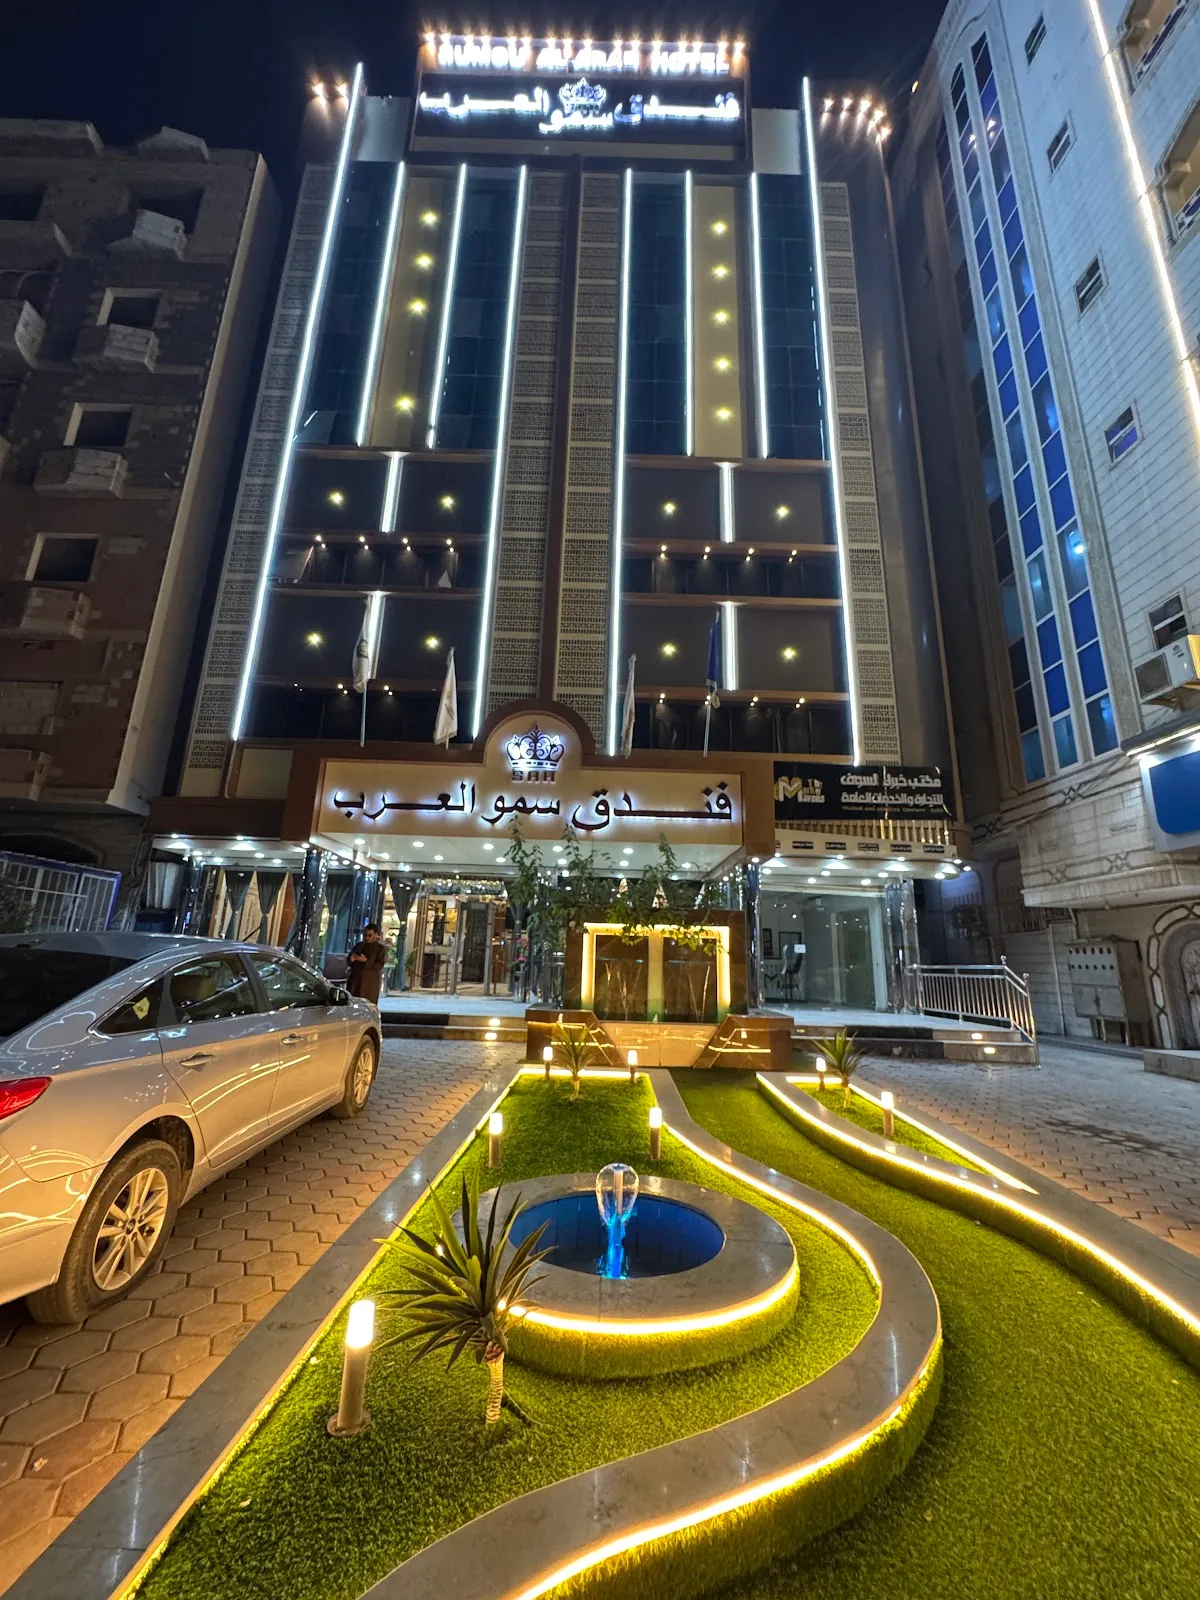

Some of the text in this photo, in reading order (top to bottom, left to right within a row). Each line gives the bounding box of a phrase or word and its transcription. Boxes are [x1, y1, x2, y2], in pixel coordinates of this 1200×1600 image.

[651, 50, 730, 74] HOTEL
[908, 774, 942, 789] مكتب
[333, 780, 732, 832] فندق سمو العرب
